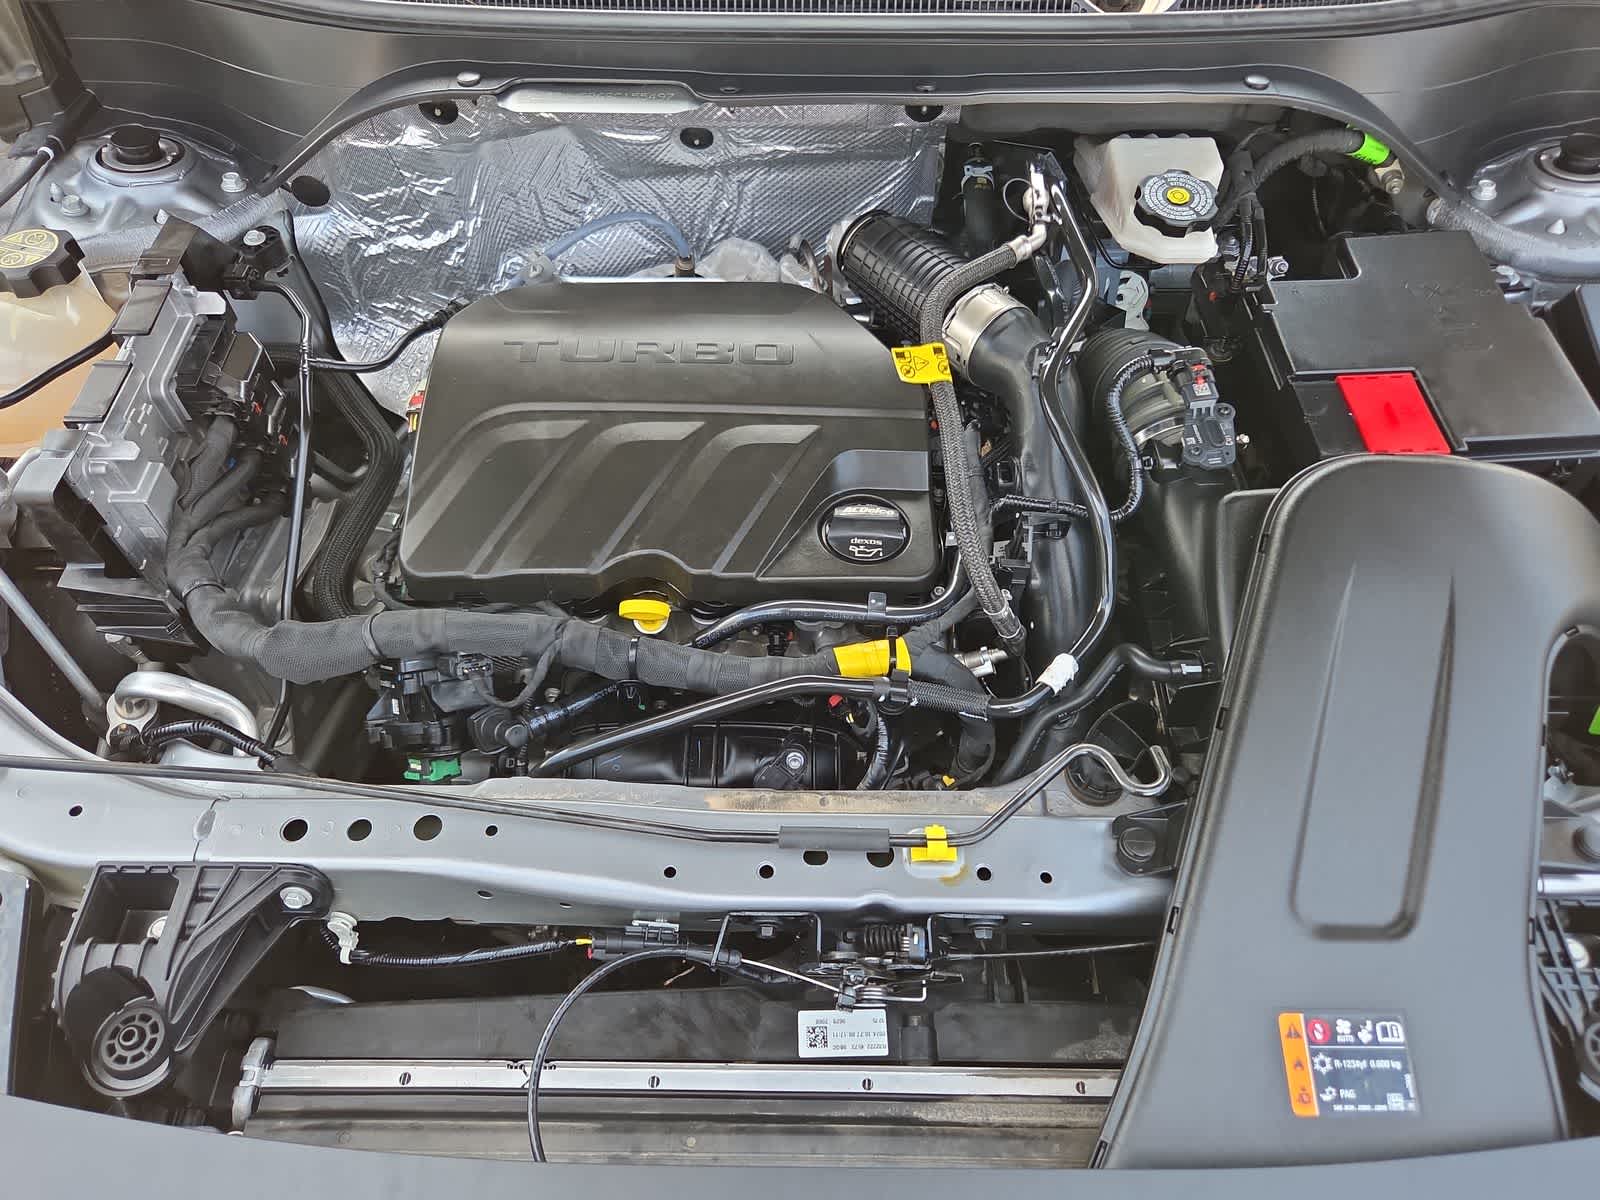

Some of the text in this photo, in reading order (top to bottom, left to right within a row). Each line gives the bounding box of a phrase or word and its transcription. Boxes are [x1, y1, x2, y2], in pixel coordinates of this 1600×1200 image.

[503, 341, 797, 365] TURBO
[842, 506, 896, 516] ACDelco
[850, 537, 883, 546] dexos
[1339, 1089, 1357, 1099] PAG
